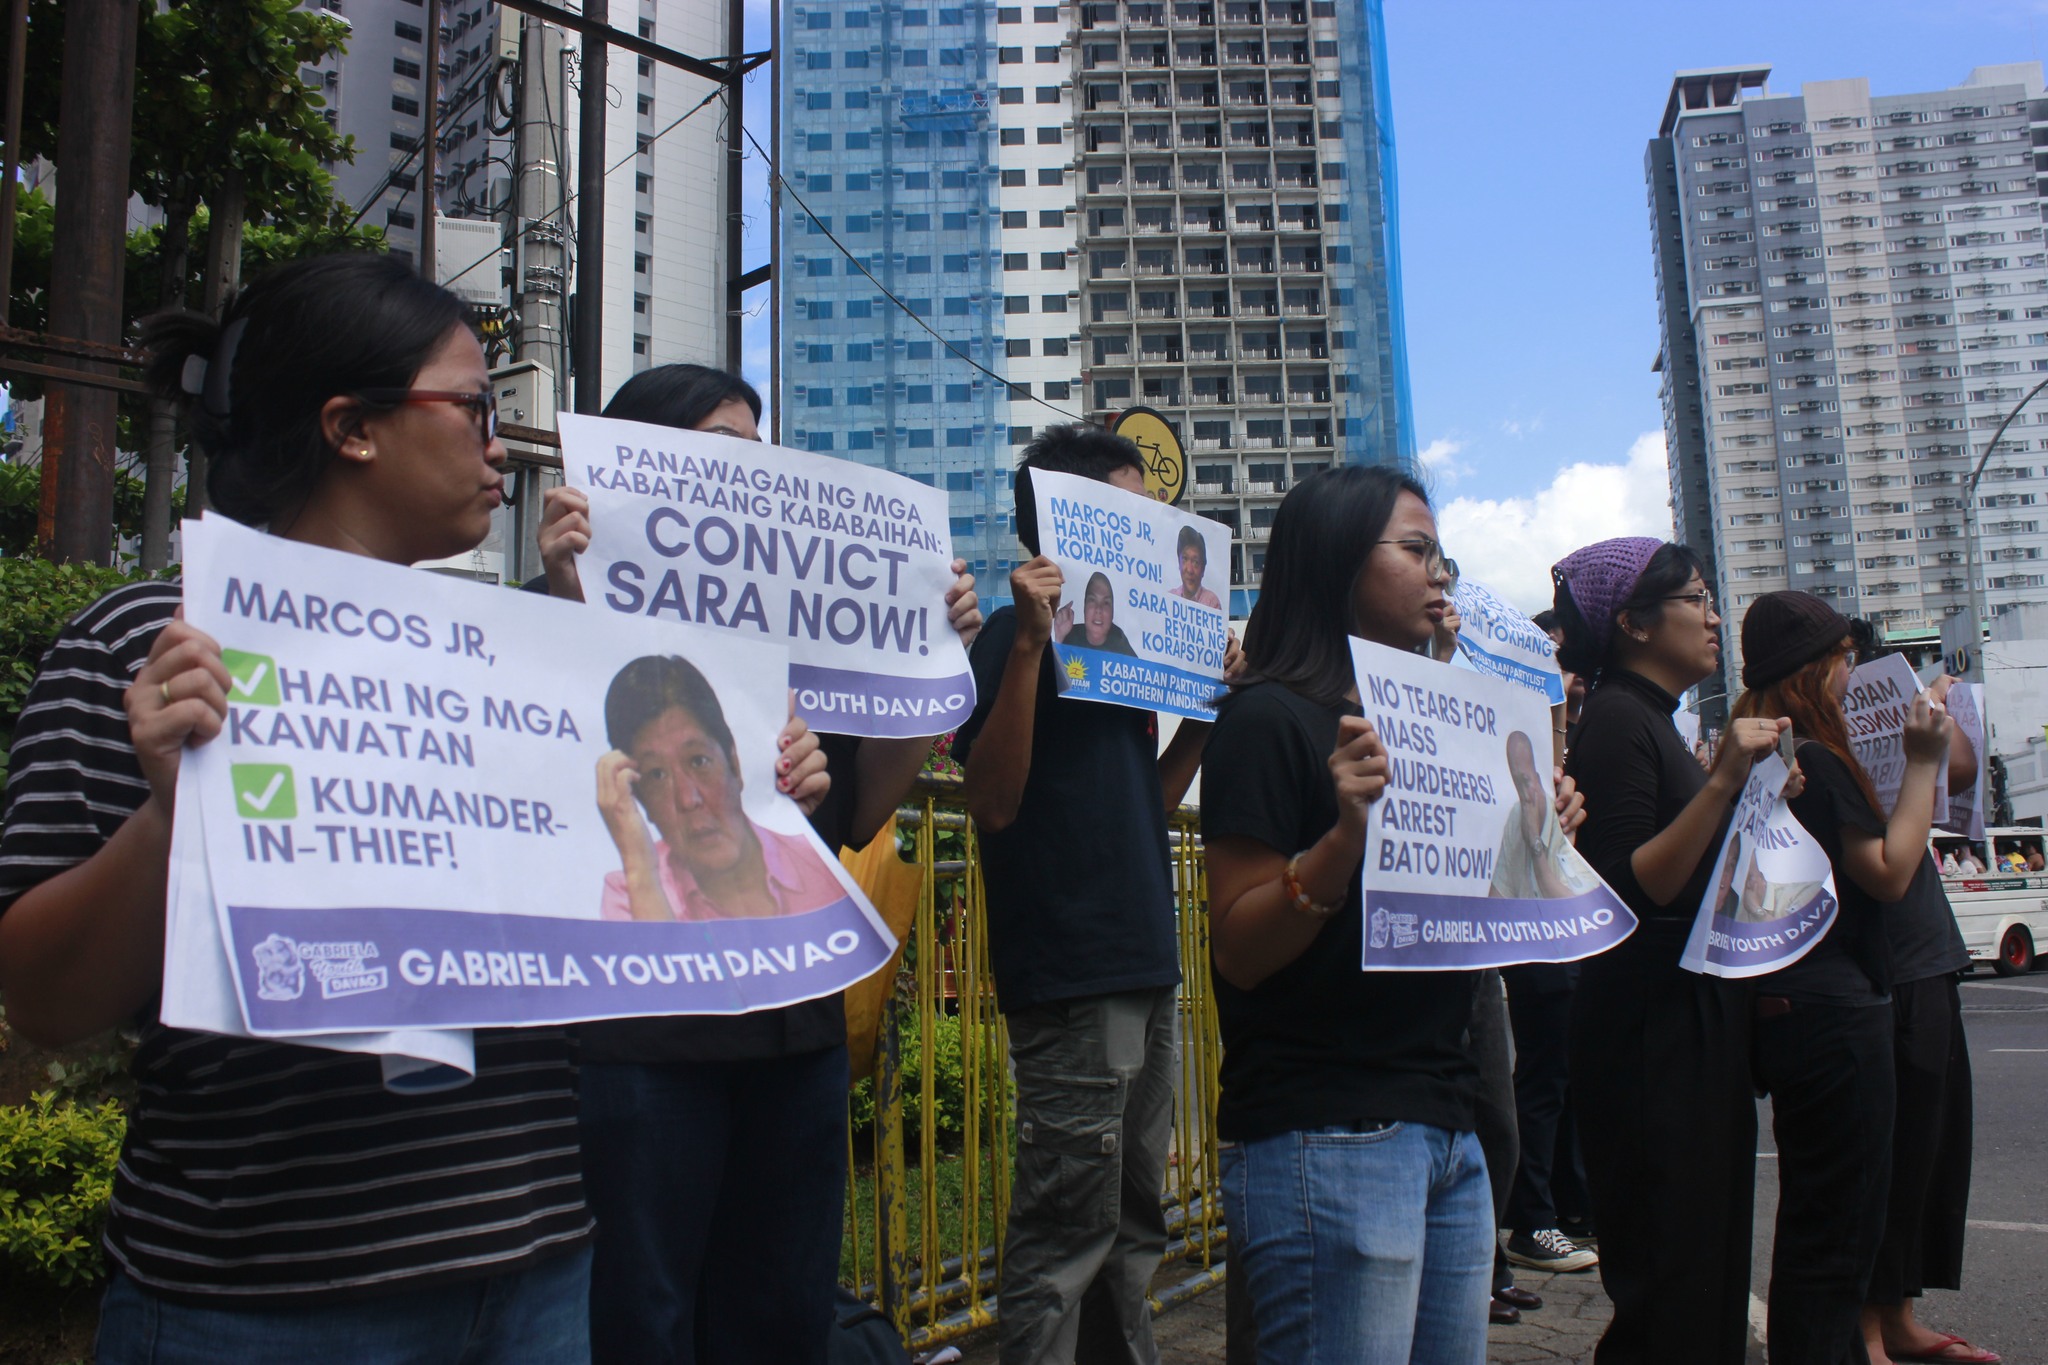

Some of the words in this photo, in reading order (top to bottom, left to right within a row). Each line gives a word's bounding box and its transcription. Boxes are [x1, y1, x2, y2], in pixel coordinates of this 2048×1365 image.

[615, 445, 810, 501] PANAWAGAN
[818, 482, 856, 510] NG
[863, 492, 922, 526] MGA
[587, 465, 772, 519] KABATAANG
[780, 500, 944, 556] KABABAIHAN:
[1050, 497, 1132, 535] MARCOS
[1136, 519, 1155, 546] JR,
[1054, 516, 1095, 544] HARI
[1101, 527, 1124, 551] NG
[645, 507, 909, 597] CONVICT
[1057, 538, 1162, 584] KORAPSYON!
[222, 577, 432, 650] MARCOS
[444, 620, 497, 667] JR,
[605, 561, 770, 634] SARA
[788, 590, 929, 656] NOW!
[1128, 588, 1168, 617] SARA
[1172, 600, 1226, 638] DUTERTE,
[1165, 617, 1205, 648] REYNA
[1209, 630, 1226, 651] NG
[1487, 620, 1552, 657] TOKHANG
[1100, 678, 1164, 704] SOUTHERN
[1102, 660, 1168, 689] KABATAAN
[1170, 676, 1216, 700] PARTYLIST
[1510, 665, 1547, 688] PARTYLIST
[278, 668, 392, 714] HARI
[405, 681, 470, 725] NG
[481, 694, 583, 743] MGA
[794, 688, 867, 715] OUTH
[873, 694, 966, 718] DAVAO
[1368, 674, 1399, 707] NO
[1403, 684, 1461, 727] TEARS
[1466, 701, 1497, 737] FOR
[229, 707, 477, 768] KAWATAN
[1377, 714, 1437, 756] MASS
[310, 776, 569, 836] KUMANDER-
[1381, 797, 1456, 837] ARREST
[243, 824, 460, 870] IN-THIEF!
[1379, 838, 1439, 876] BATO
[1445, 845, 1492, 881] NOW!
[1423, 918, 1487, 944] GABRIELA
[1487, 918, 1539, 943] YOUTH
[1541, 908, 1613, 940] DAVAO
[1729, 933, 1784, 952] YOUTH
[1784, 893, 1832, 940] DAVA
[298, 941, 379, 959] GABRIELA
[399, 949, 590, 987] GABRIELA
[591, 949, 722, 987] YOUTH
[723, 929, 860, 975] DAVAO
[331, 974, 379, 991] DAVAO
